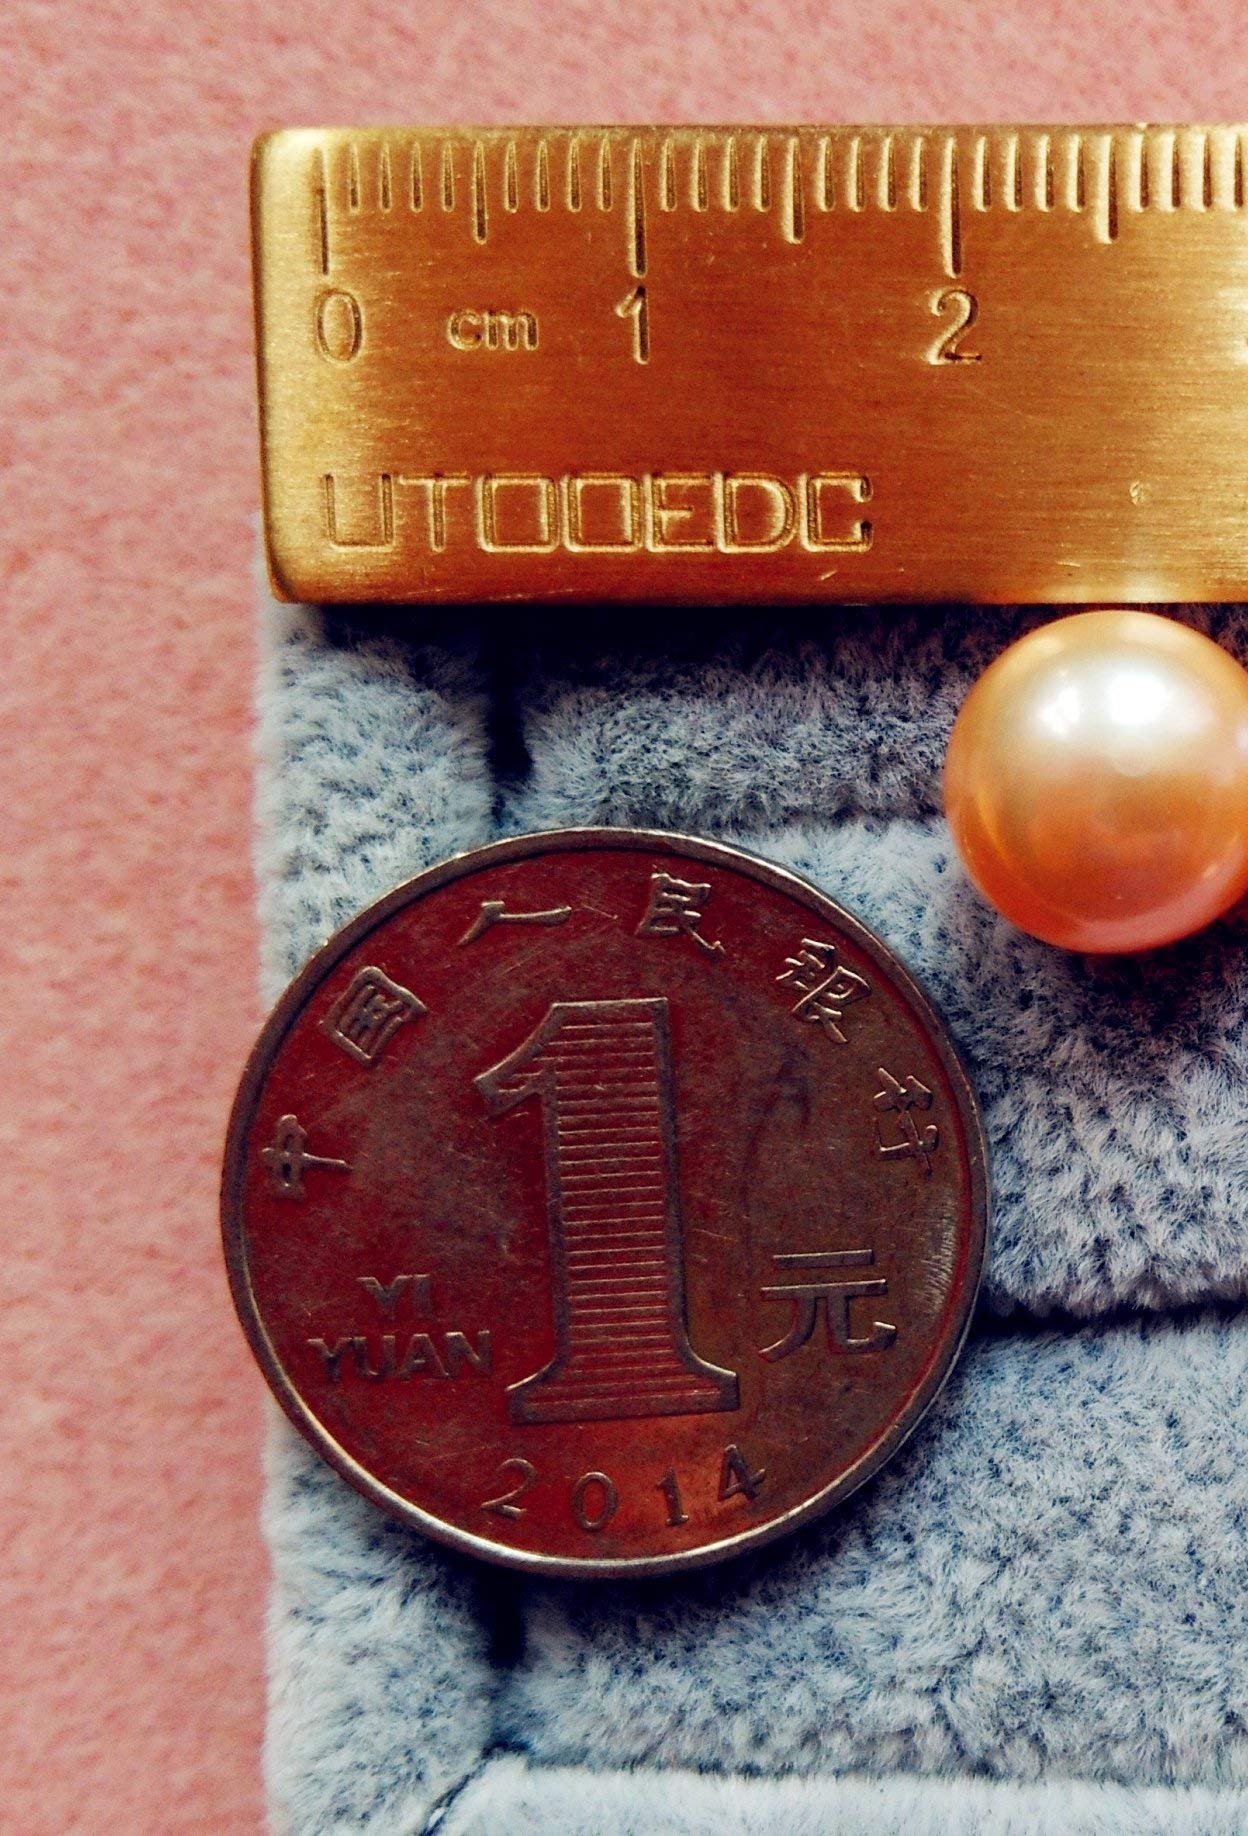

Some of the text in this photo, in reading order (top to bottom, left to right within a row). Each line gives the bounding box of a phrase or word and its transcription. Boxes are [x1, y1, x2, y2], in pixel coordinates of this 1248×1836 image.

[316, 287, 364, 364] 0
[446, 307, 541, 352] cm
[614, 284, 651, 365] 1
[926, 285, 983, 365] 2
[322, 472, 876, 555] UTOOEDC
[472, 996, 742, 1425] 1
[356, 1272, 432, 1322] YI
[757, 1248, 898, 1363] 元
[305, 1329, 493, 1383] YUAN
[480, 1443, 767, 1532] 2014
